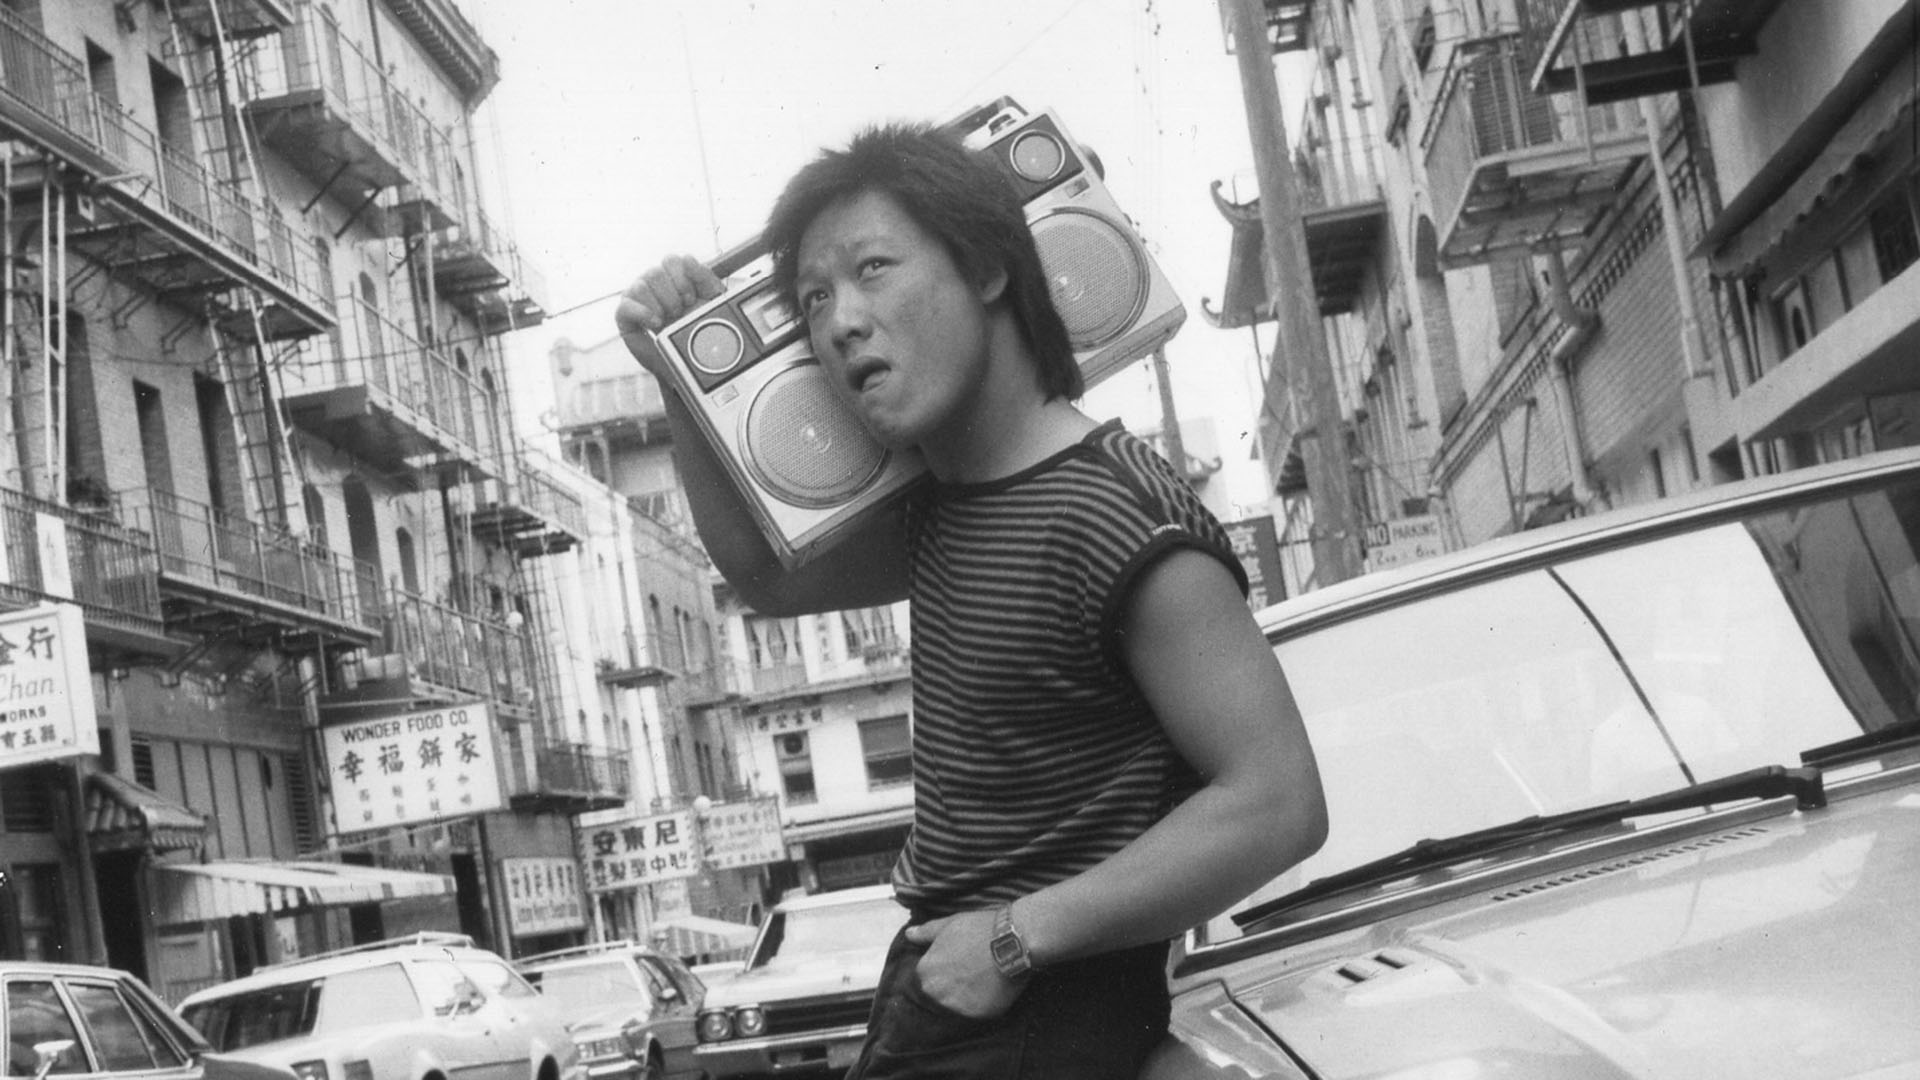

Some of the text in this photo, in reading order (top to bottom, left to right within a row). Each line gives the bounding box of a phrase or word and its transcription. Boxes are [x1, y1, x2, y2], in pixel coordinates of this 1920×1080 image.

[1366, 524, 1387, 546] NO
[341, 720, 401, 744] WONDER
[407, 713, 443, 733] FOOD
[593, 819, 679, 857] 安東尼
